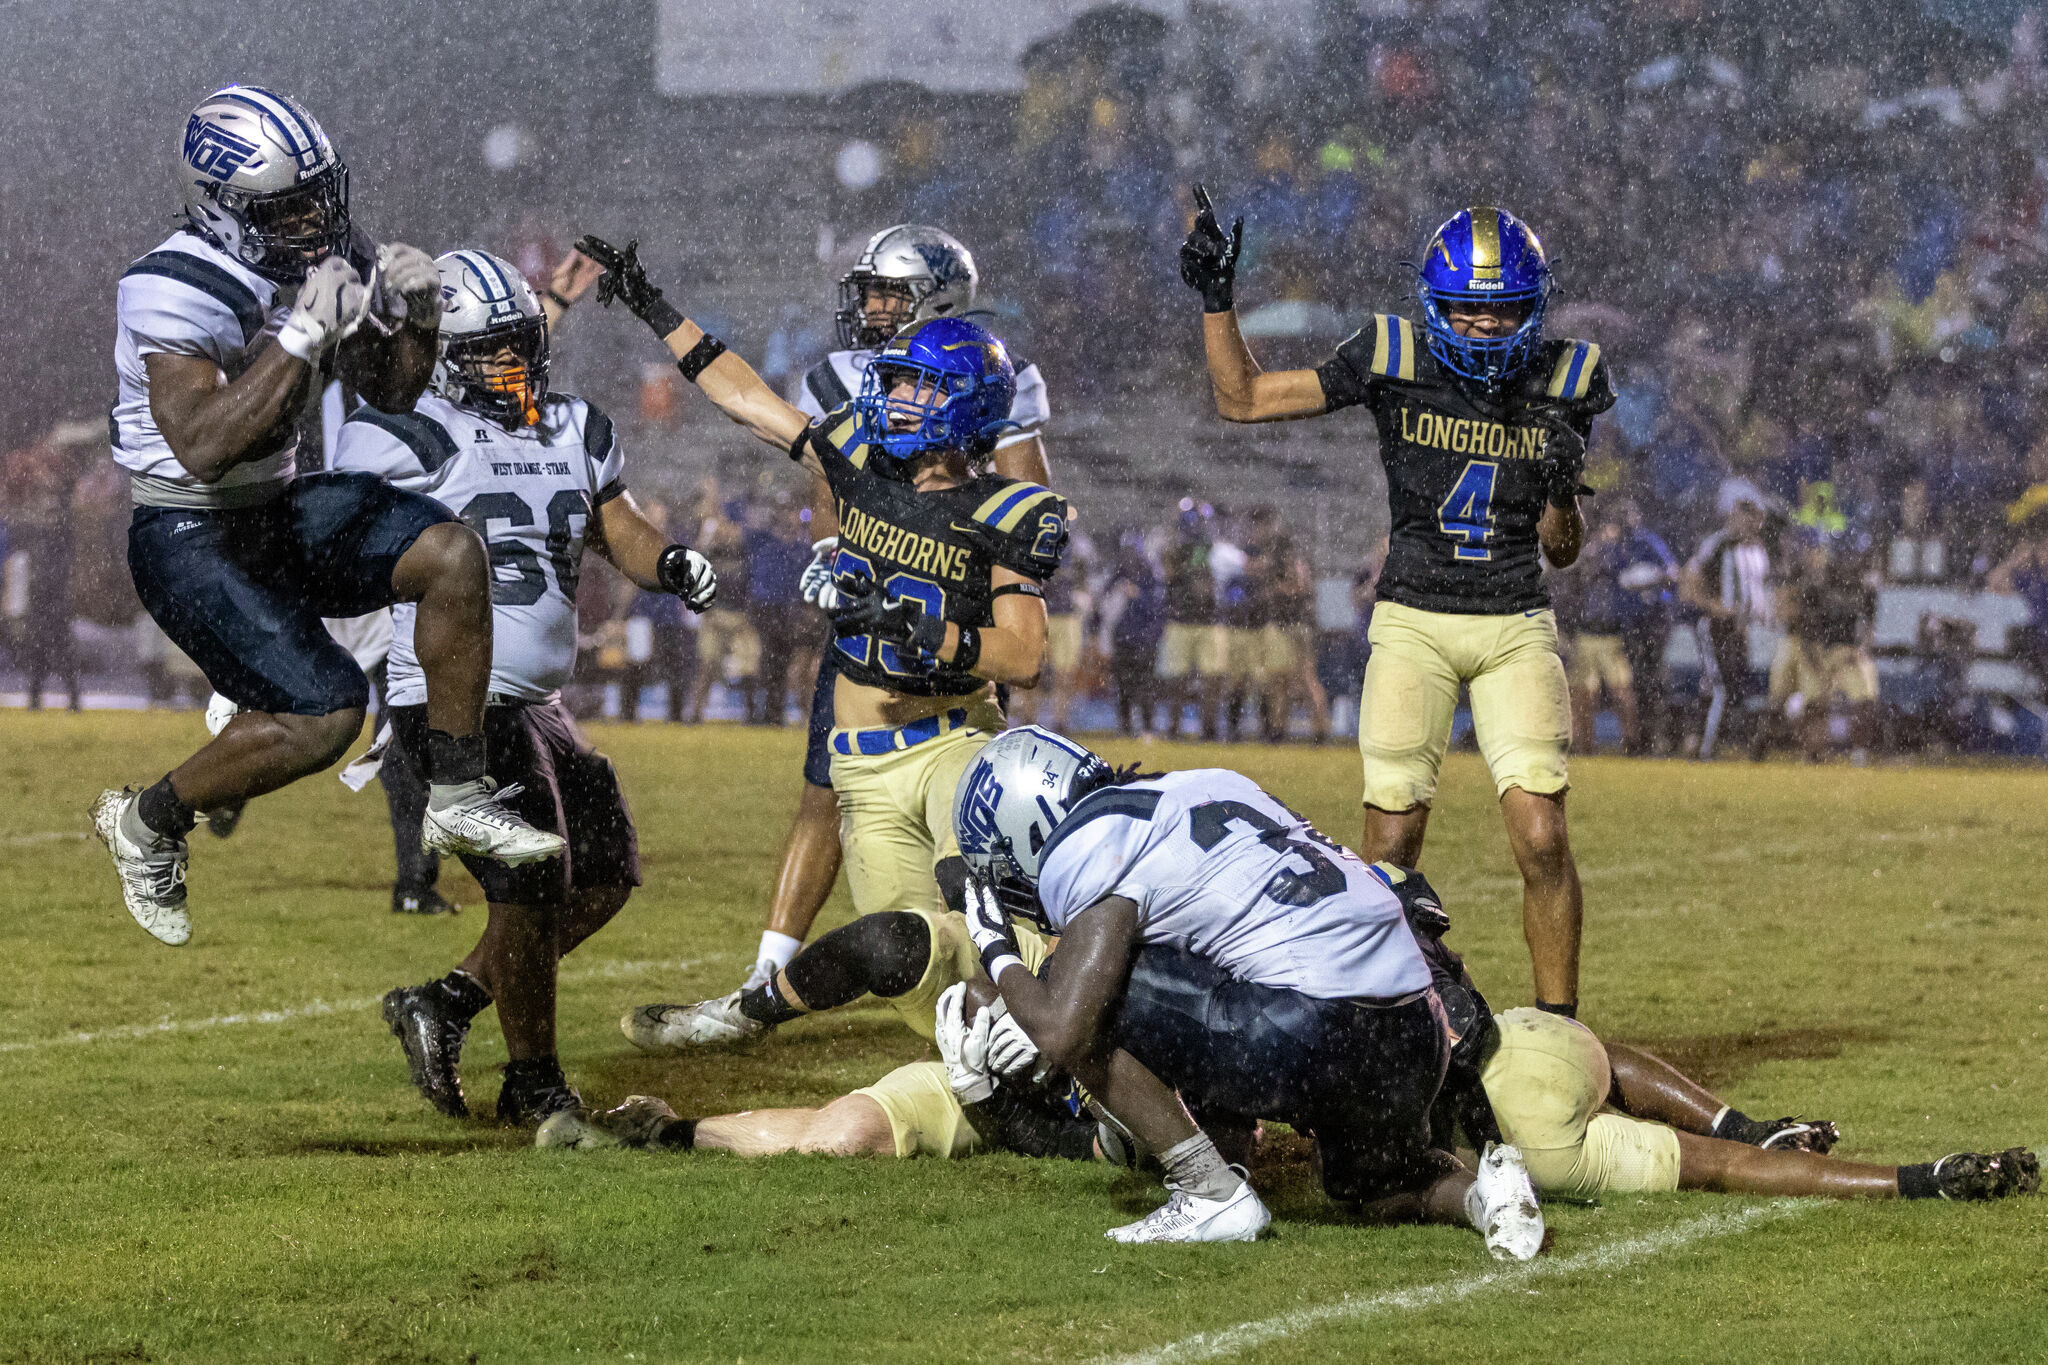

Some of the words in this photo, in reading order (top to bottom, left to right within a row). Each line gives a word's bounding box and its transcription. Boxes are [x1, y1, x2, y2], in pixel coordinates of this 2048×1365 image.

[300, 160, 328, 180] Riddell
[1469, 280, 1504, 290] Riddell
[1401, 407, 1545, 460] LONGHORNS
[491, 462, 513, 476] WEST
[1437, 459, 1499, 561] 4
[838, 498, 971, 581] LONGHORNS
[1042, 770, 1059, 788] 34
